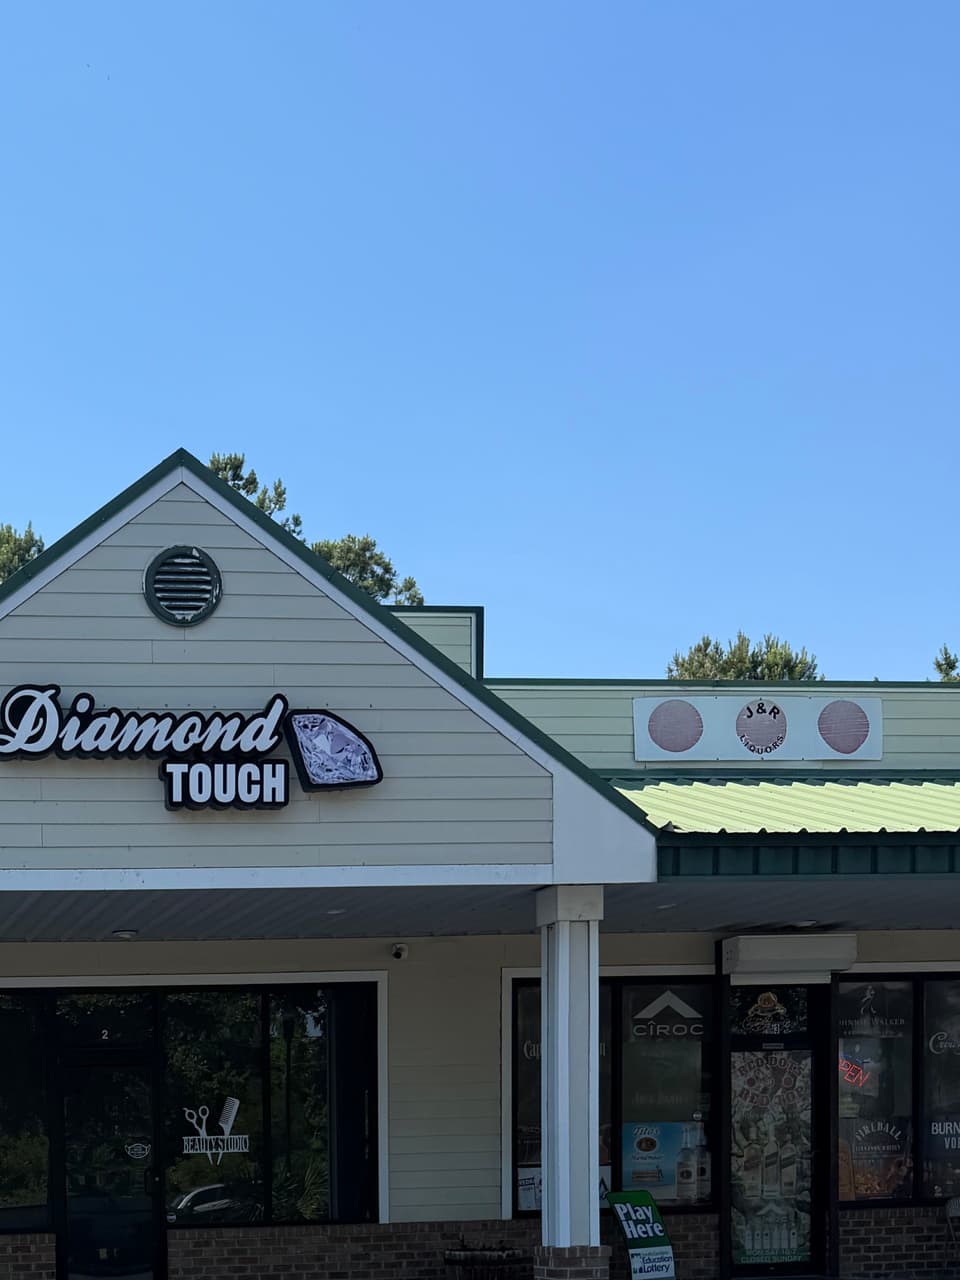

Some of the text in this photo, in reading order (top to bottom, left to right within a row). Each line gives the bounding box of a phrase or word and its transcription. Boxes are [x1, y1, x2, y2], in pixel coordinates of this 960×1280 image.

[739, 734, 784, 755] LIQUORS
[166, 762, 286, 804] TOUCH
[101, 1028, 109, 1040] 2
[839, 1059, 871, 1088] PEN
[184, 1137, 249, 1152] BEAUTY STUDIO
[614, 1203, 653, 1222] Play
[623, 1220, 665, 1239] Here
[642, 1256, 673, 1265] Education
[643, 1263, 670, 1273] Lottery
